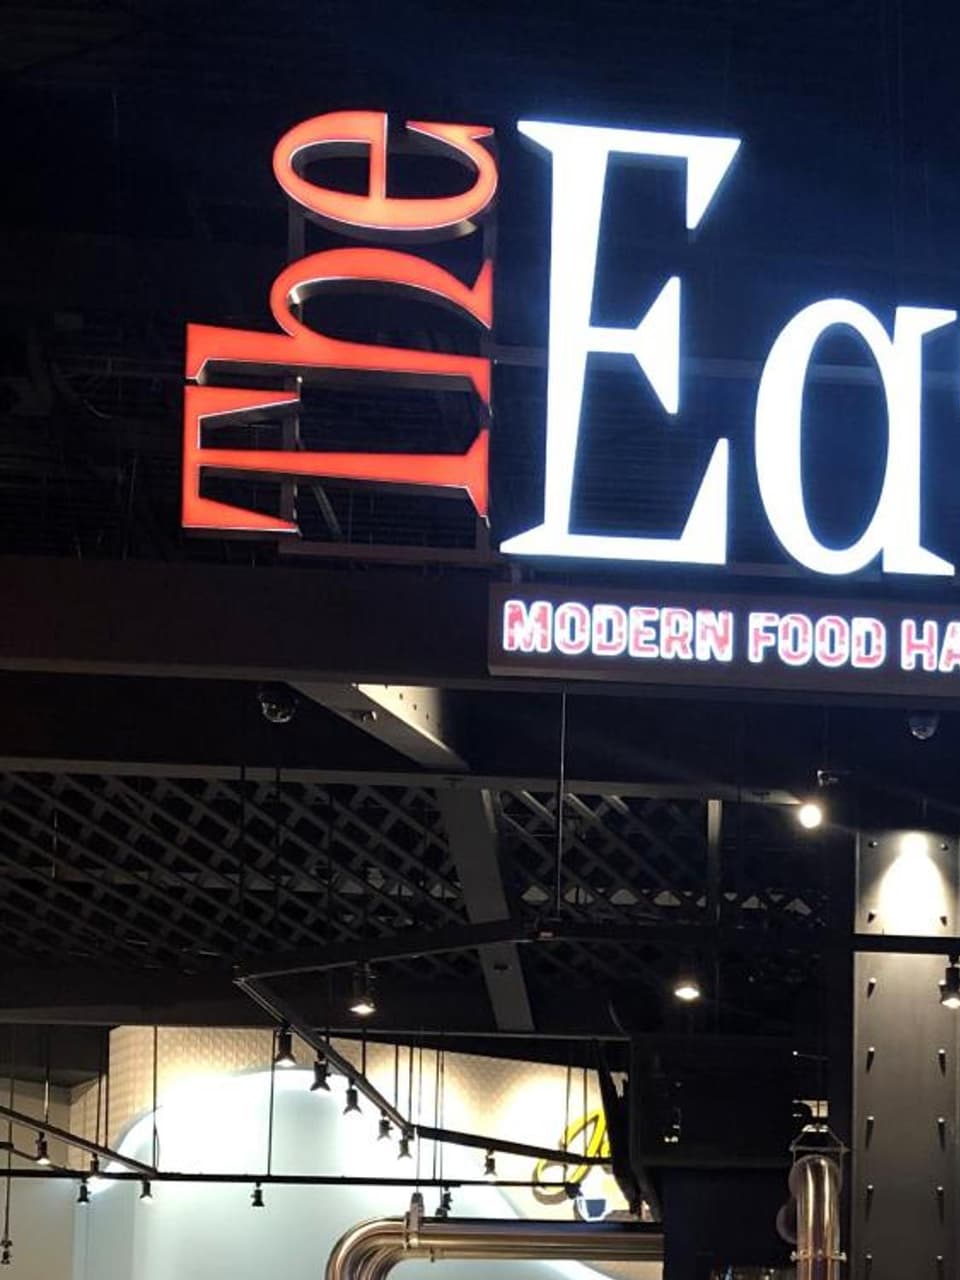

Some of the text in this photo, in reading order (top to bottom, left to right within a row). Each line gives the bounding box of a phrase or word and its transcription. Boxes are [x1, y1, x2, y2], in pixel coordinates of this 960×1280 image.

[182, 110, 498, 532] The
[502, 599, 735, 662] MODERN
[748, 612, 887, 668] FOOD
